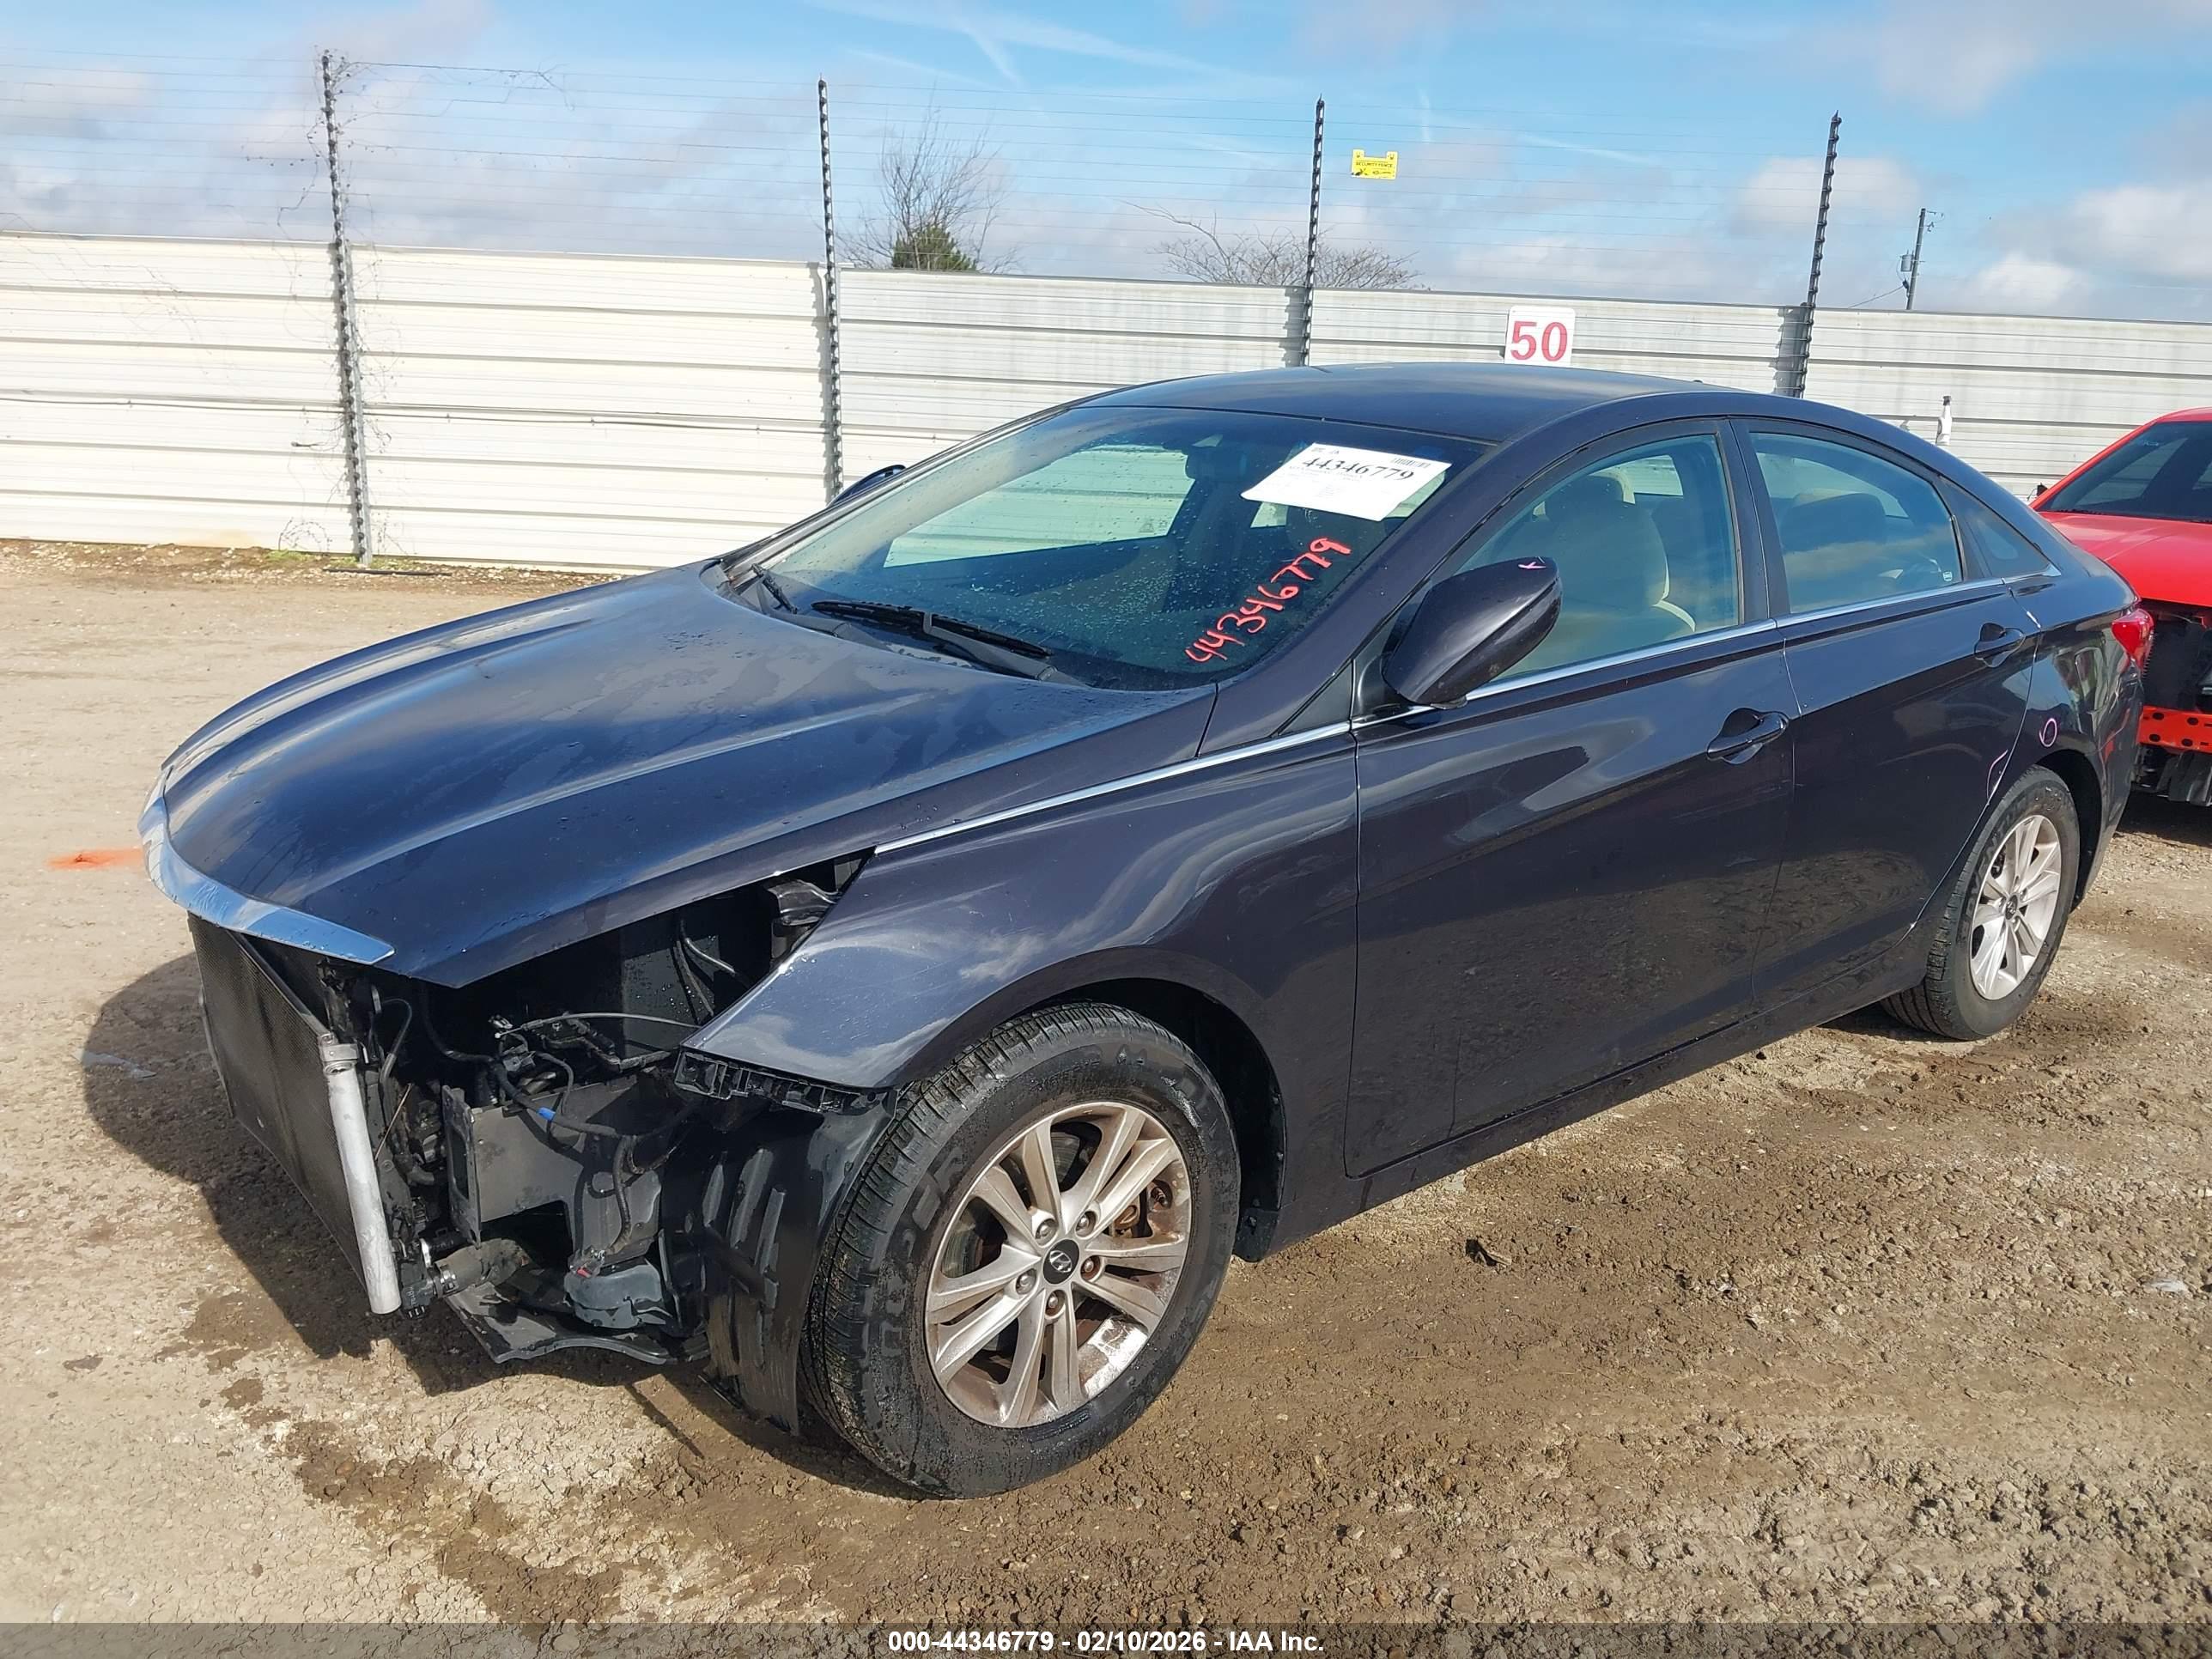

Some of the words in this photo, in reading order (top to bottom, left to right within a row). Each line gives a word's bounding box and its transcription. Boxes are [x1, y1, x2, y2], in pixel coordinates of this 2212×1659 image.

[1510, 320, 1568, 362] 50
[1303, 457, 1415, 481] 44346779
[1185, 537, 1352, 662] 44346779
